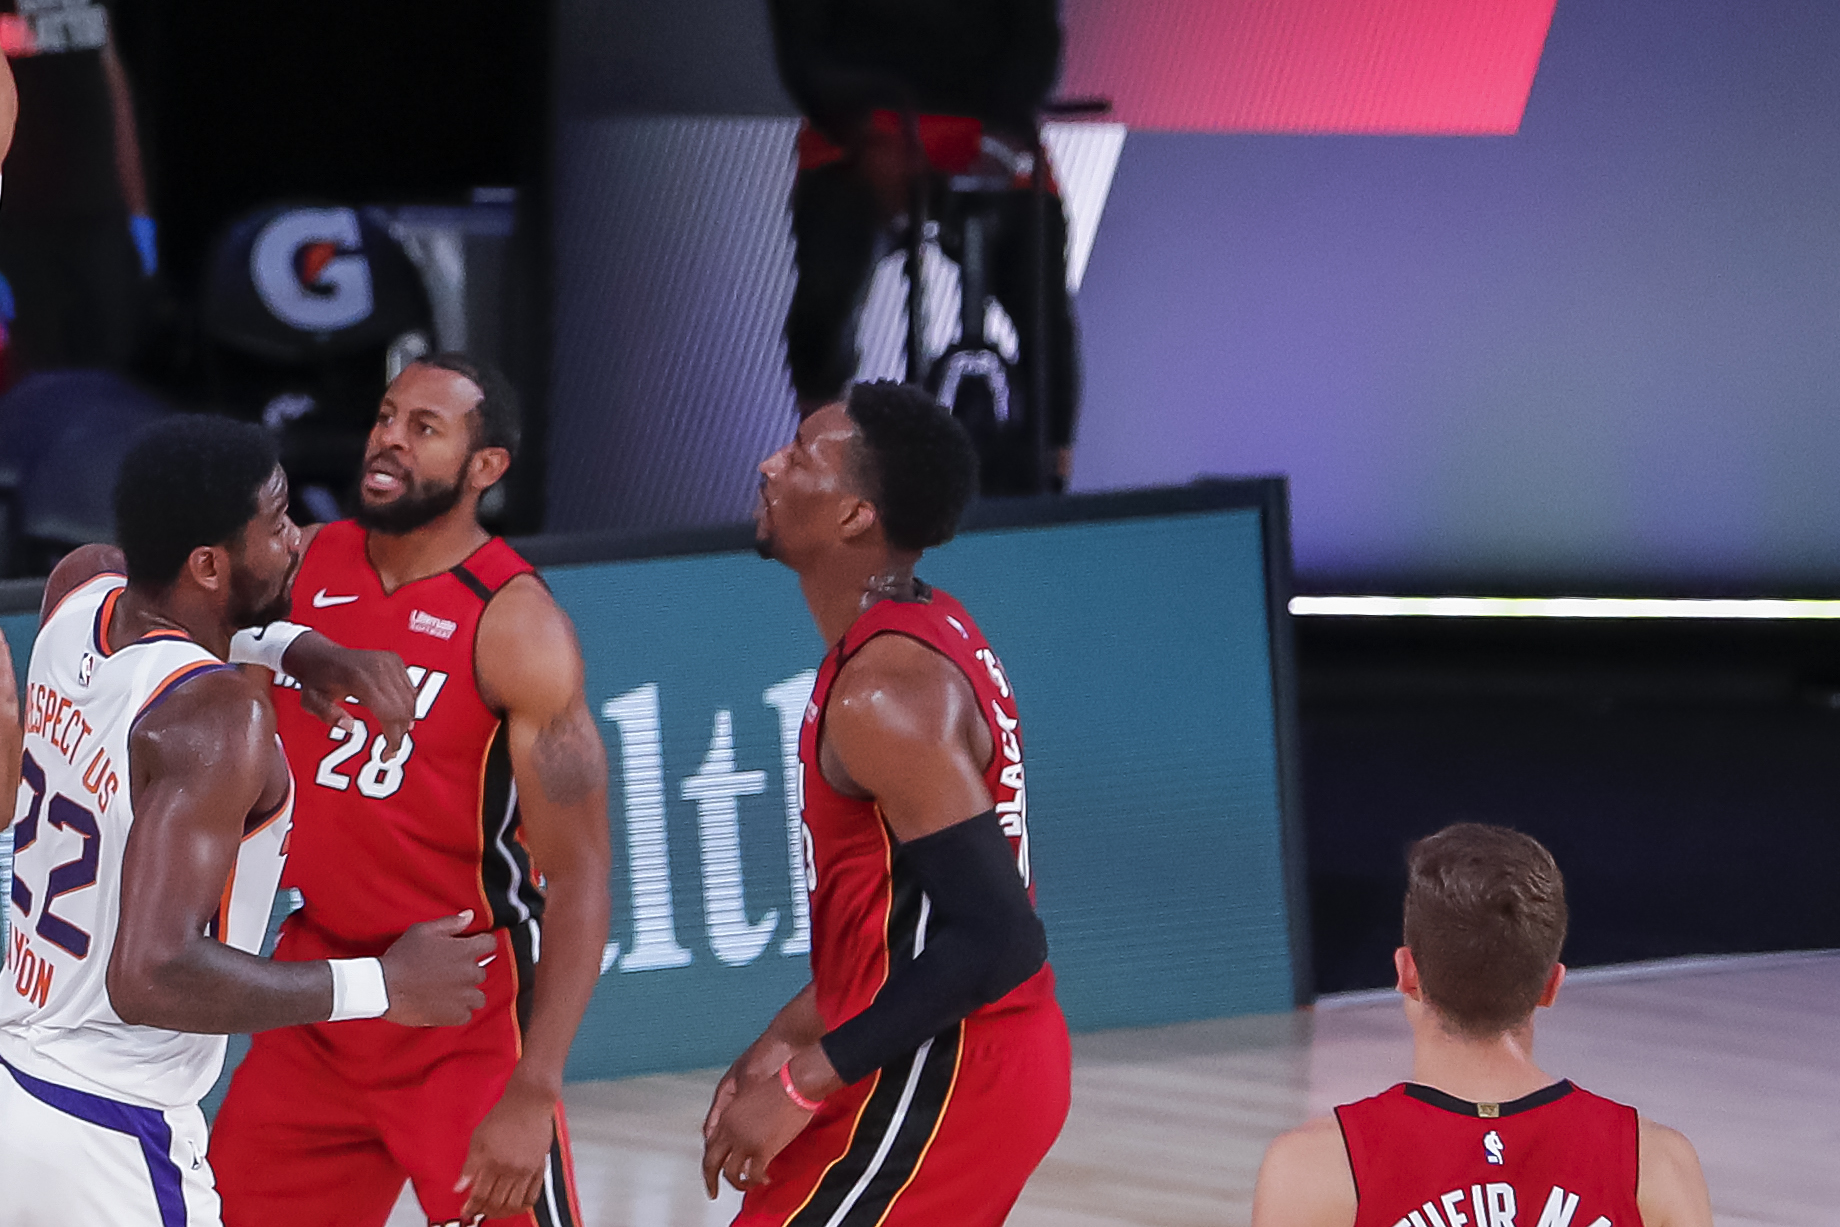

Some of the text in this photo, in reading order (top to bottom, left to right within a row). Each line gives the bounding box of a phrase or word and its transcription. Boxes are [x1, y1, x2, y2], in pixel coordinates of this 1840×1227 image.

[250, 206, 375, 335] G
[24, 681, 118, 813] ESPECT US
[314, 718, 415, 799] 28
[10, 747, 101, 961] 22
